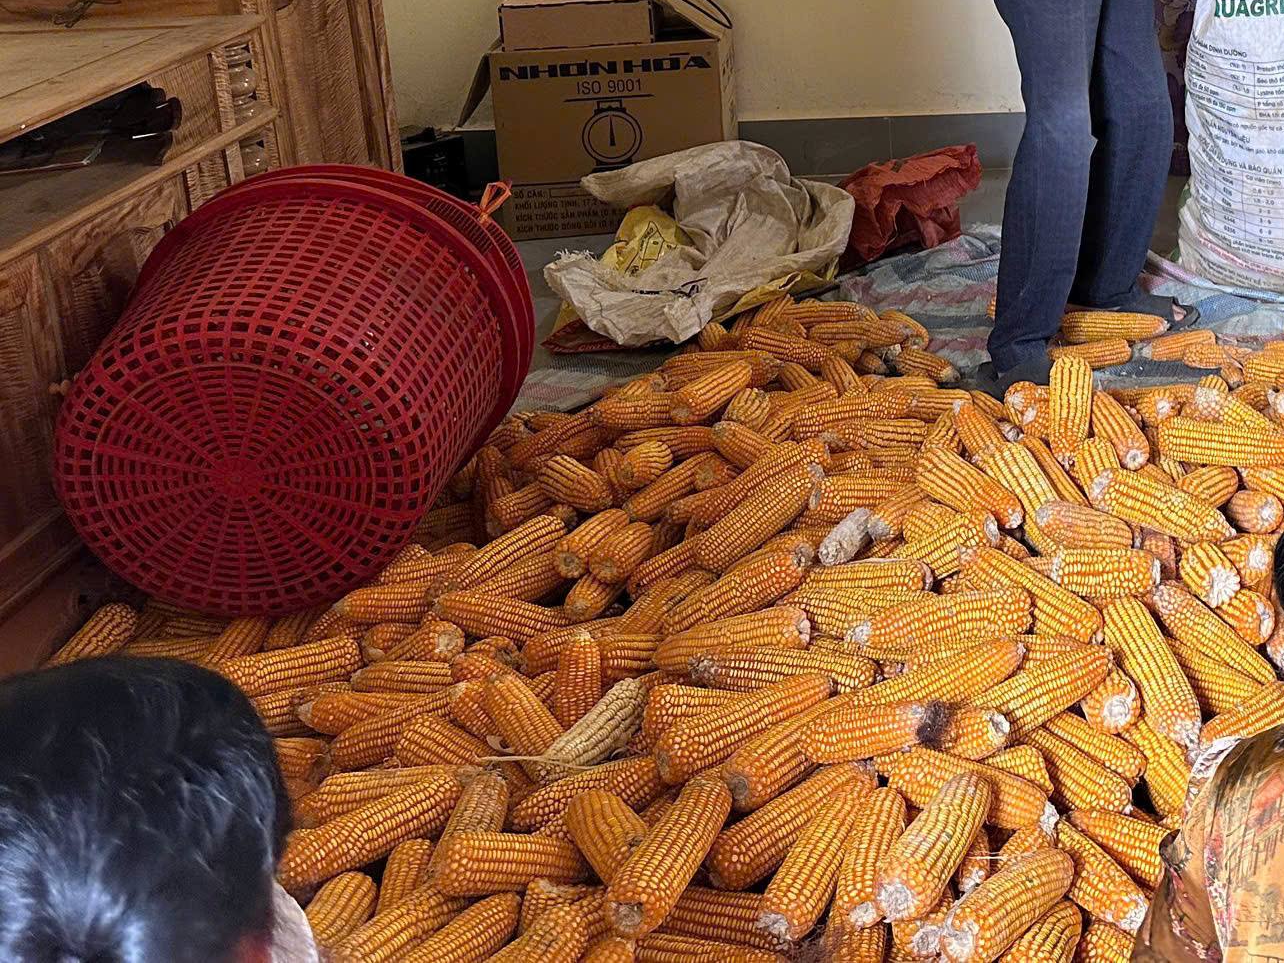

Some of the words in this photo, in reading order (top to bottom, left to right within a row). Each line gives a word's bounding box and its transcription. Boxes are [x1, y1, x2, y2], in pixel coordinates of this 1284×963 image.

[499, 59, 618, 81] NHƠN
[577, 81, 601, 95] ISO
[608, 79, 642, 94] 9001
